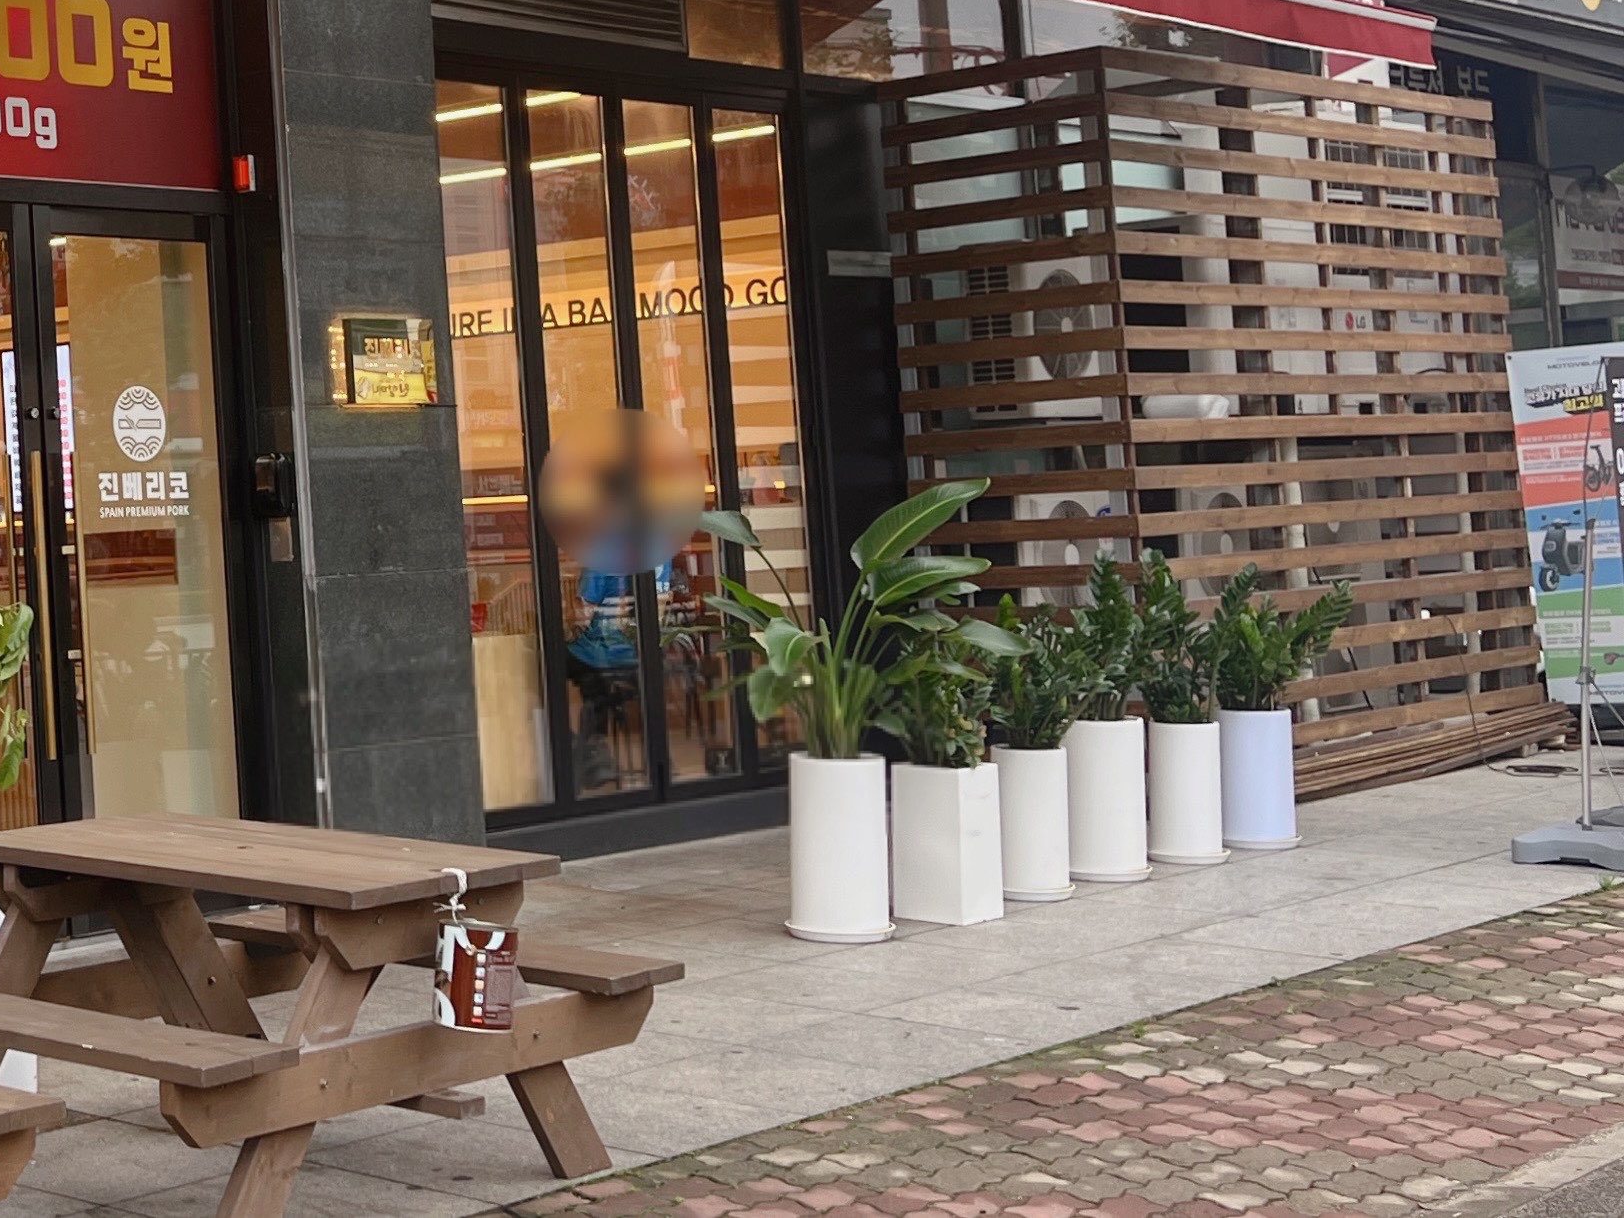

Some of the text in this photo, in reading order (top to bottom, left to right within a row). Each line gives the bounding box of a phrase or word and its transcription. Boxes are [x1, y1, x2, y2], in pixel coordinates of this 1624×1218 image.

[98, 472, 189, 502] 진베리코
[100, 504, 189, 519] SPAIN PREMIUM PORK
